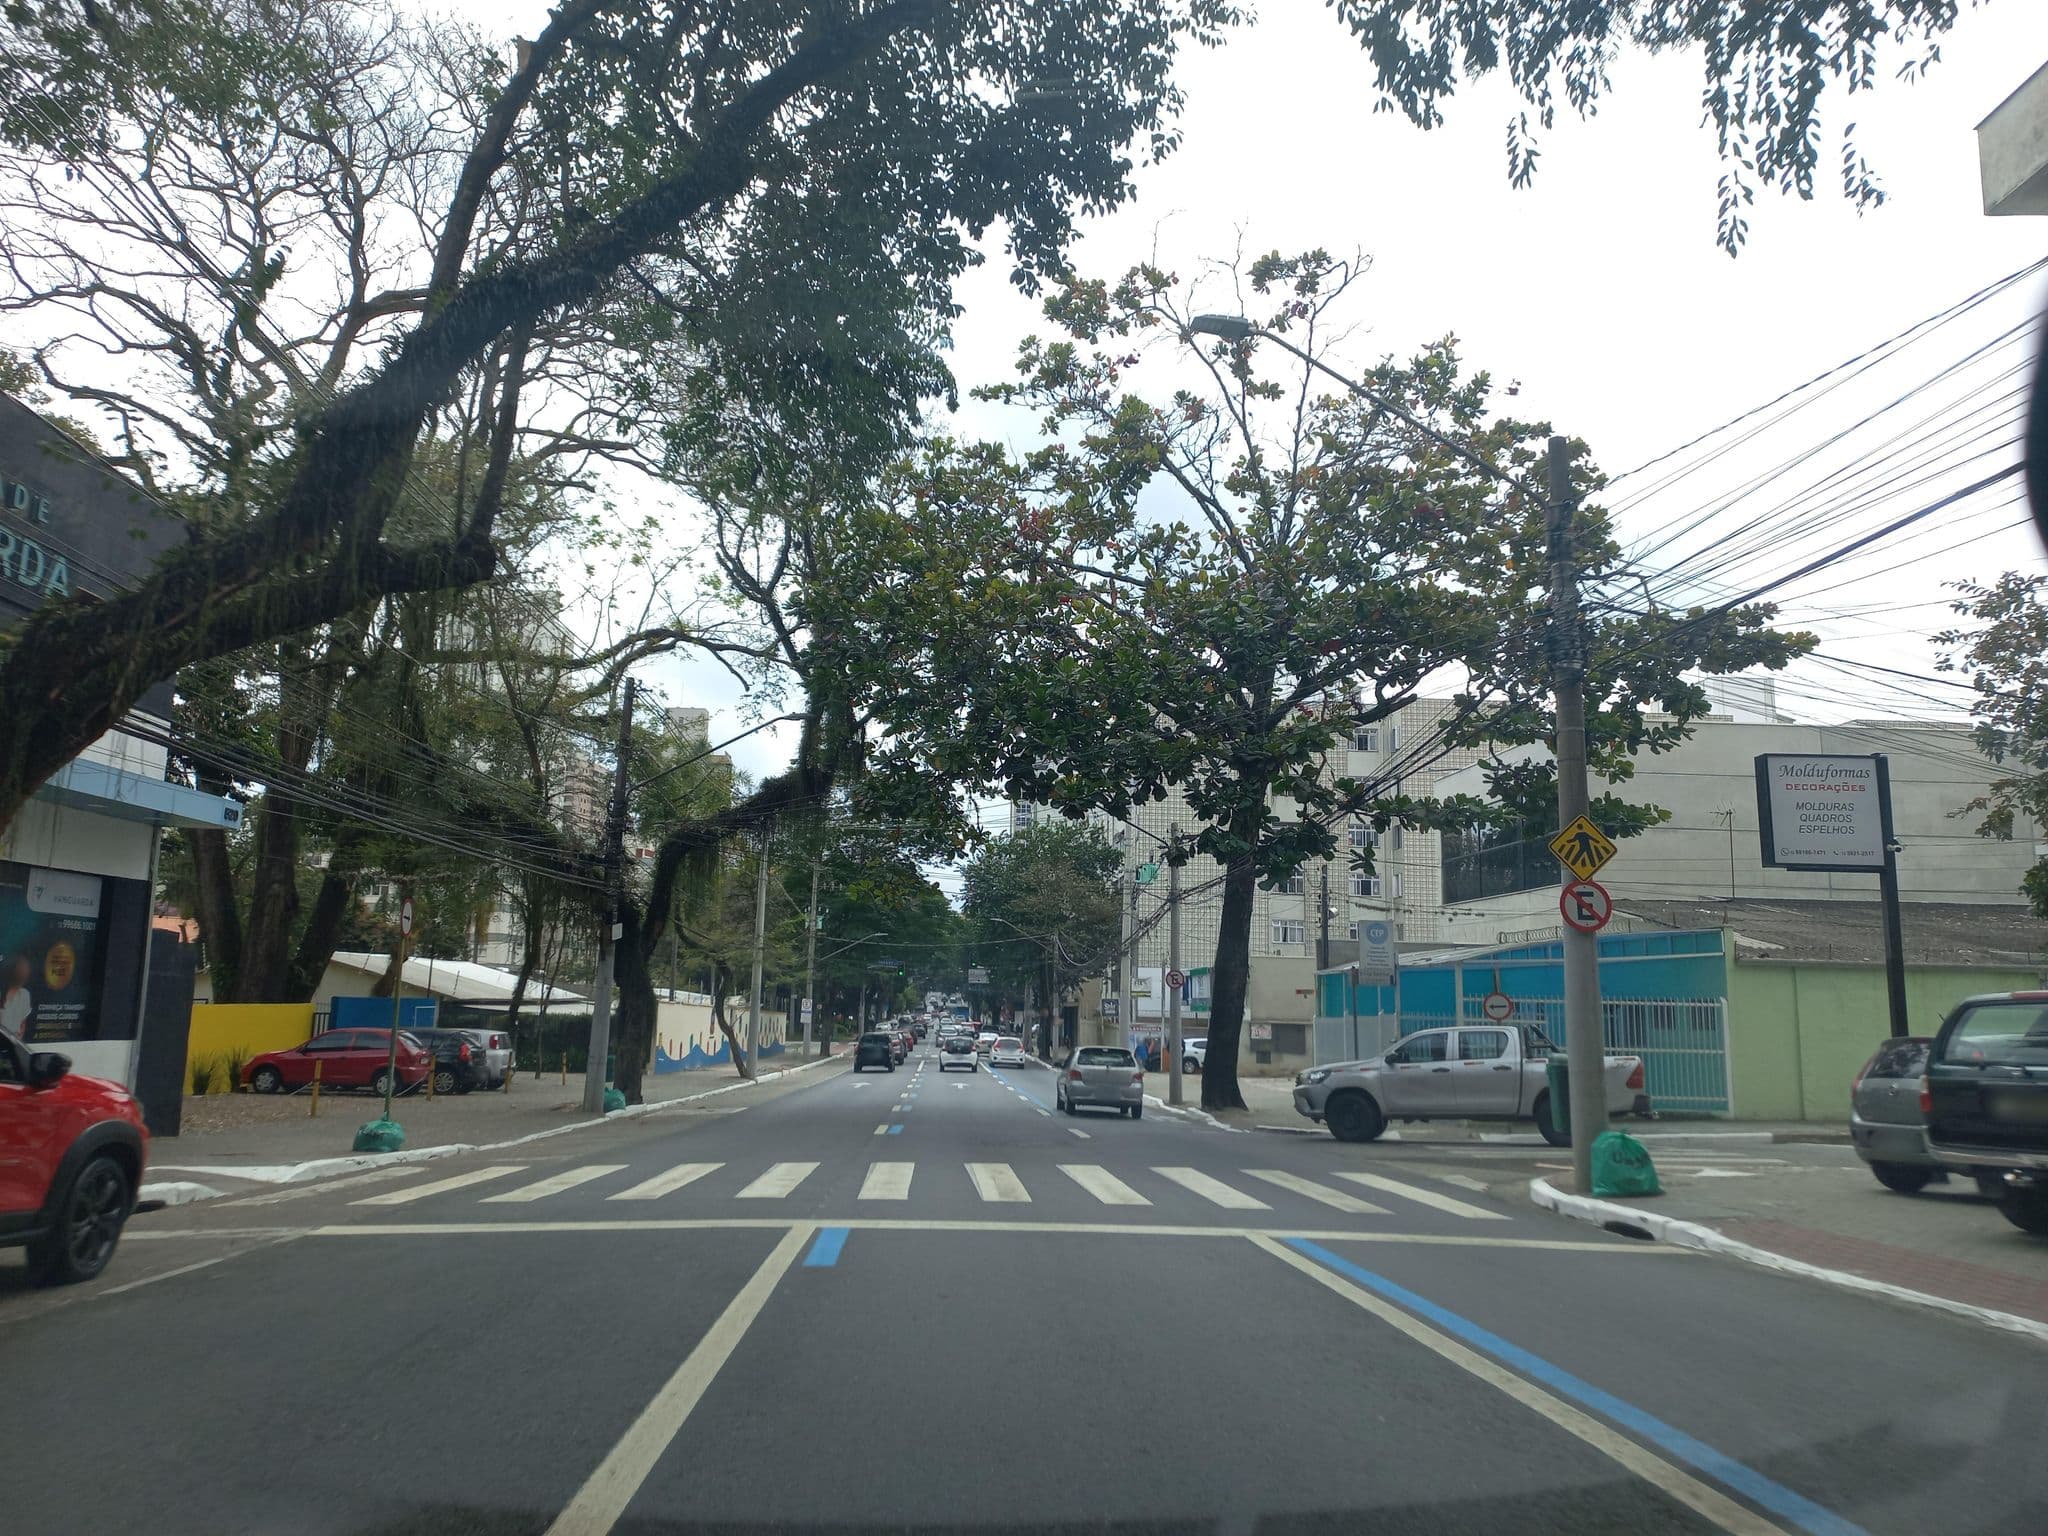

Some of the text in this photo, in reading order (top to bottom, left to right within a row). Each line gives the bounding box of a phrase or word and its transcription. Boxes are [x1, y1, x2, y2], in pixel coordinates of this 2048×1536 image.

[1779, 763, 1871, 783] Molduformas
[1785, 782, 1866, 794] DECORAÇÕES
[1795, 802, 1855, 812] MOLDURAS
[1799, 813, 1853, 823] QUADROS
[1799, 825, 1855, 835] ESPELHOS
